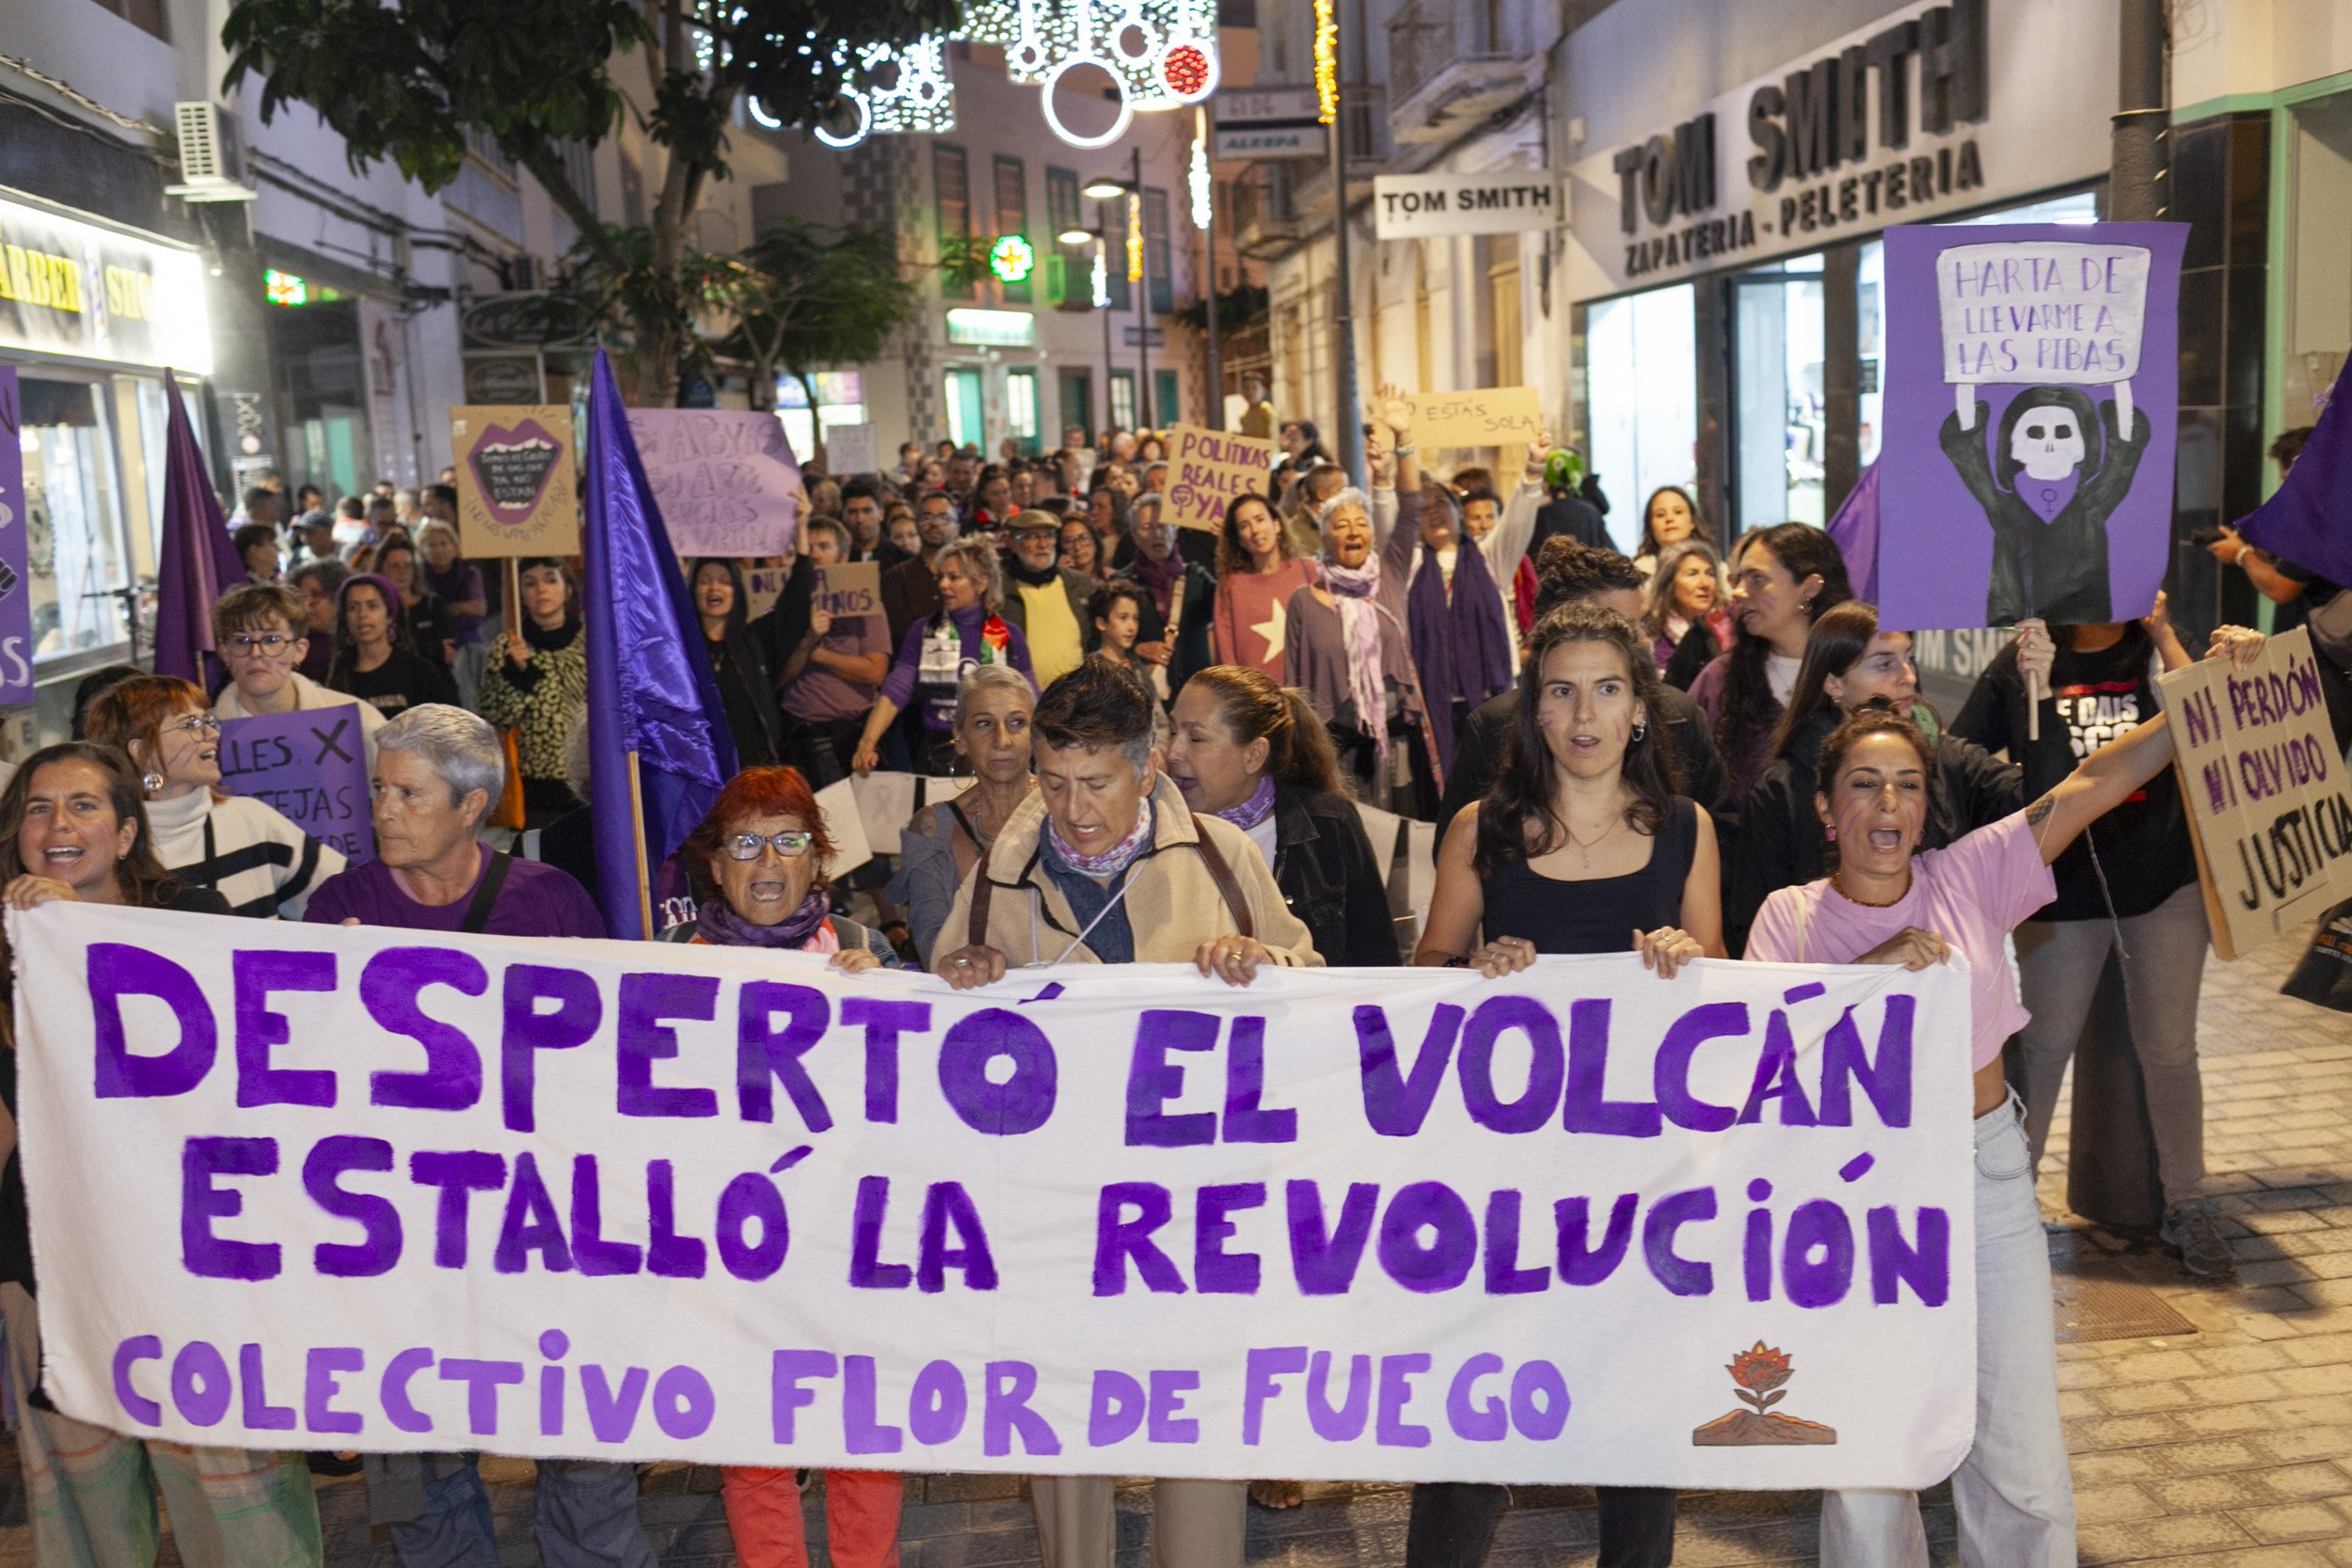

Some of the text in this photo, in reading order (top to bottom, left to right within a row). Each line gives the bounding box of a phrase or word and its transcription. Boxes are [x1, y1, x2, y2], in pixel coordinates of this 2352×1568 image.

[1614, 0, 1989, 234] TOM SMITH
[1383, 185, 1550, 214] TOM SMITH
[1626, 210, 1756, 277] ZAPATERIA
[1781, 140, 1984, 237] PELETERIA
[1956, 257, 2123, 297] HARTA DE
[1965, 304, 2115, 334] LLEVARME A
[1959, 338, 2125, 375] LAS PIBAS
[1426, 398, 1487, 420] ESTÁS
[1486, 416, 1536, 435] SOLA
[1181, 433, 1270, 469] POLÍTICAS
[1181, 464, 1257, 495] REALES
[1196, 493, 1225, 520] YA
[2077, 693, 2139, 726] DAIS
[2183, 654, 2323, 748] NI PERDÓN
[310, 718, 354, 766] X
[2203, 733, 2328, 816] NI OLVIDO
[2238, 791, 2352, 911] JUSTICIA
[87, 942, 1916, 1148] DESPERTÓ EL VOLCÁN
[182, 1134, 815, 1282] ESTALLÓ
[848, 1175, 998, 1293] LA
[771, 1350, 1062, 1457] FLOR
[1088, 1370, 1200, 1448] DE
[1243, 1347, 1571, 1449] FUEGO
